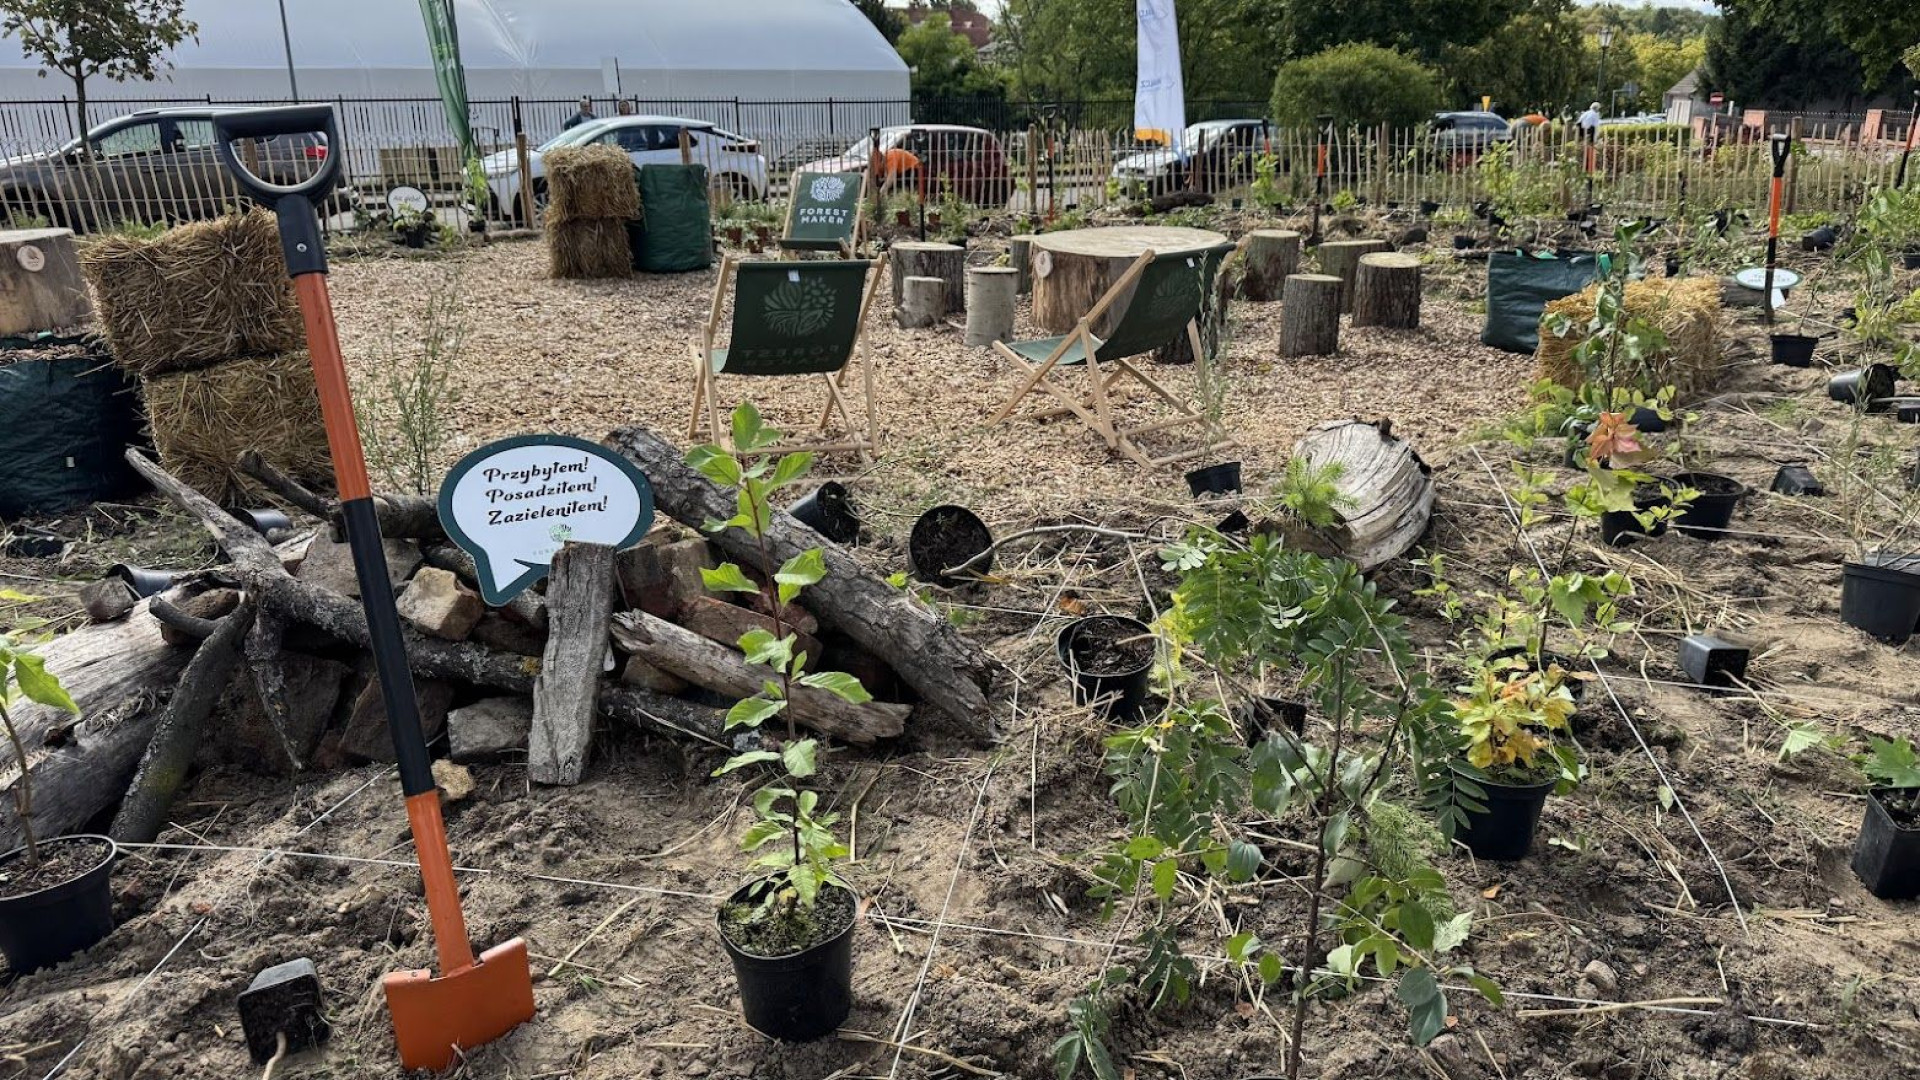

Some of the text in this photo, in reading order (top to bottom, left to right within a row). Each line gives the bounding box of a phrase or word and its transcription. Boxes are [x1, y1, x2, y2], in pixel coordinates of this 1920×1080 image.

[800, 207, 849, 216] FOREST
[801, 215, 844, 225] MAKER
[482, 456, 589, 484] Przybyłem!
[485, 476, 598, 504] Posadziłem!
[488, 495, 608, 526] Zazieleniłem!
